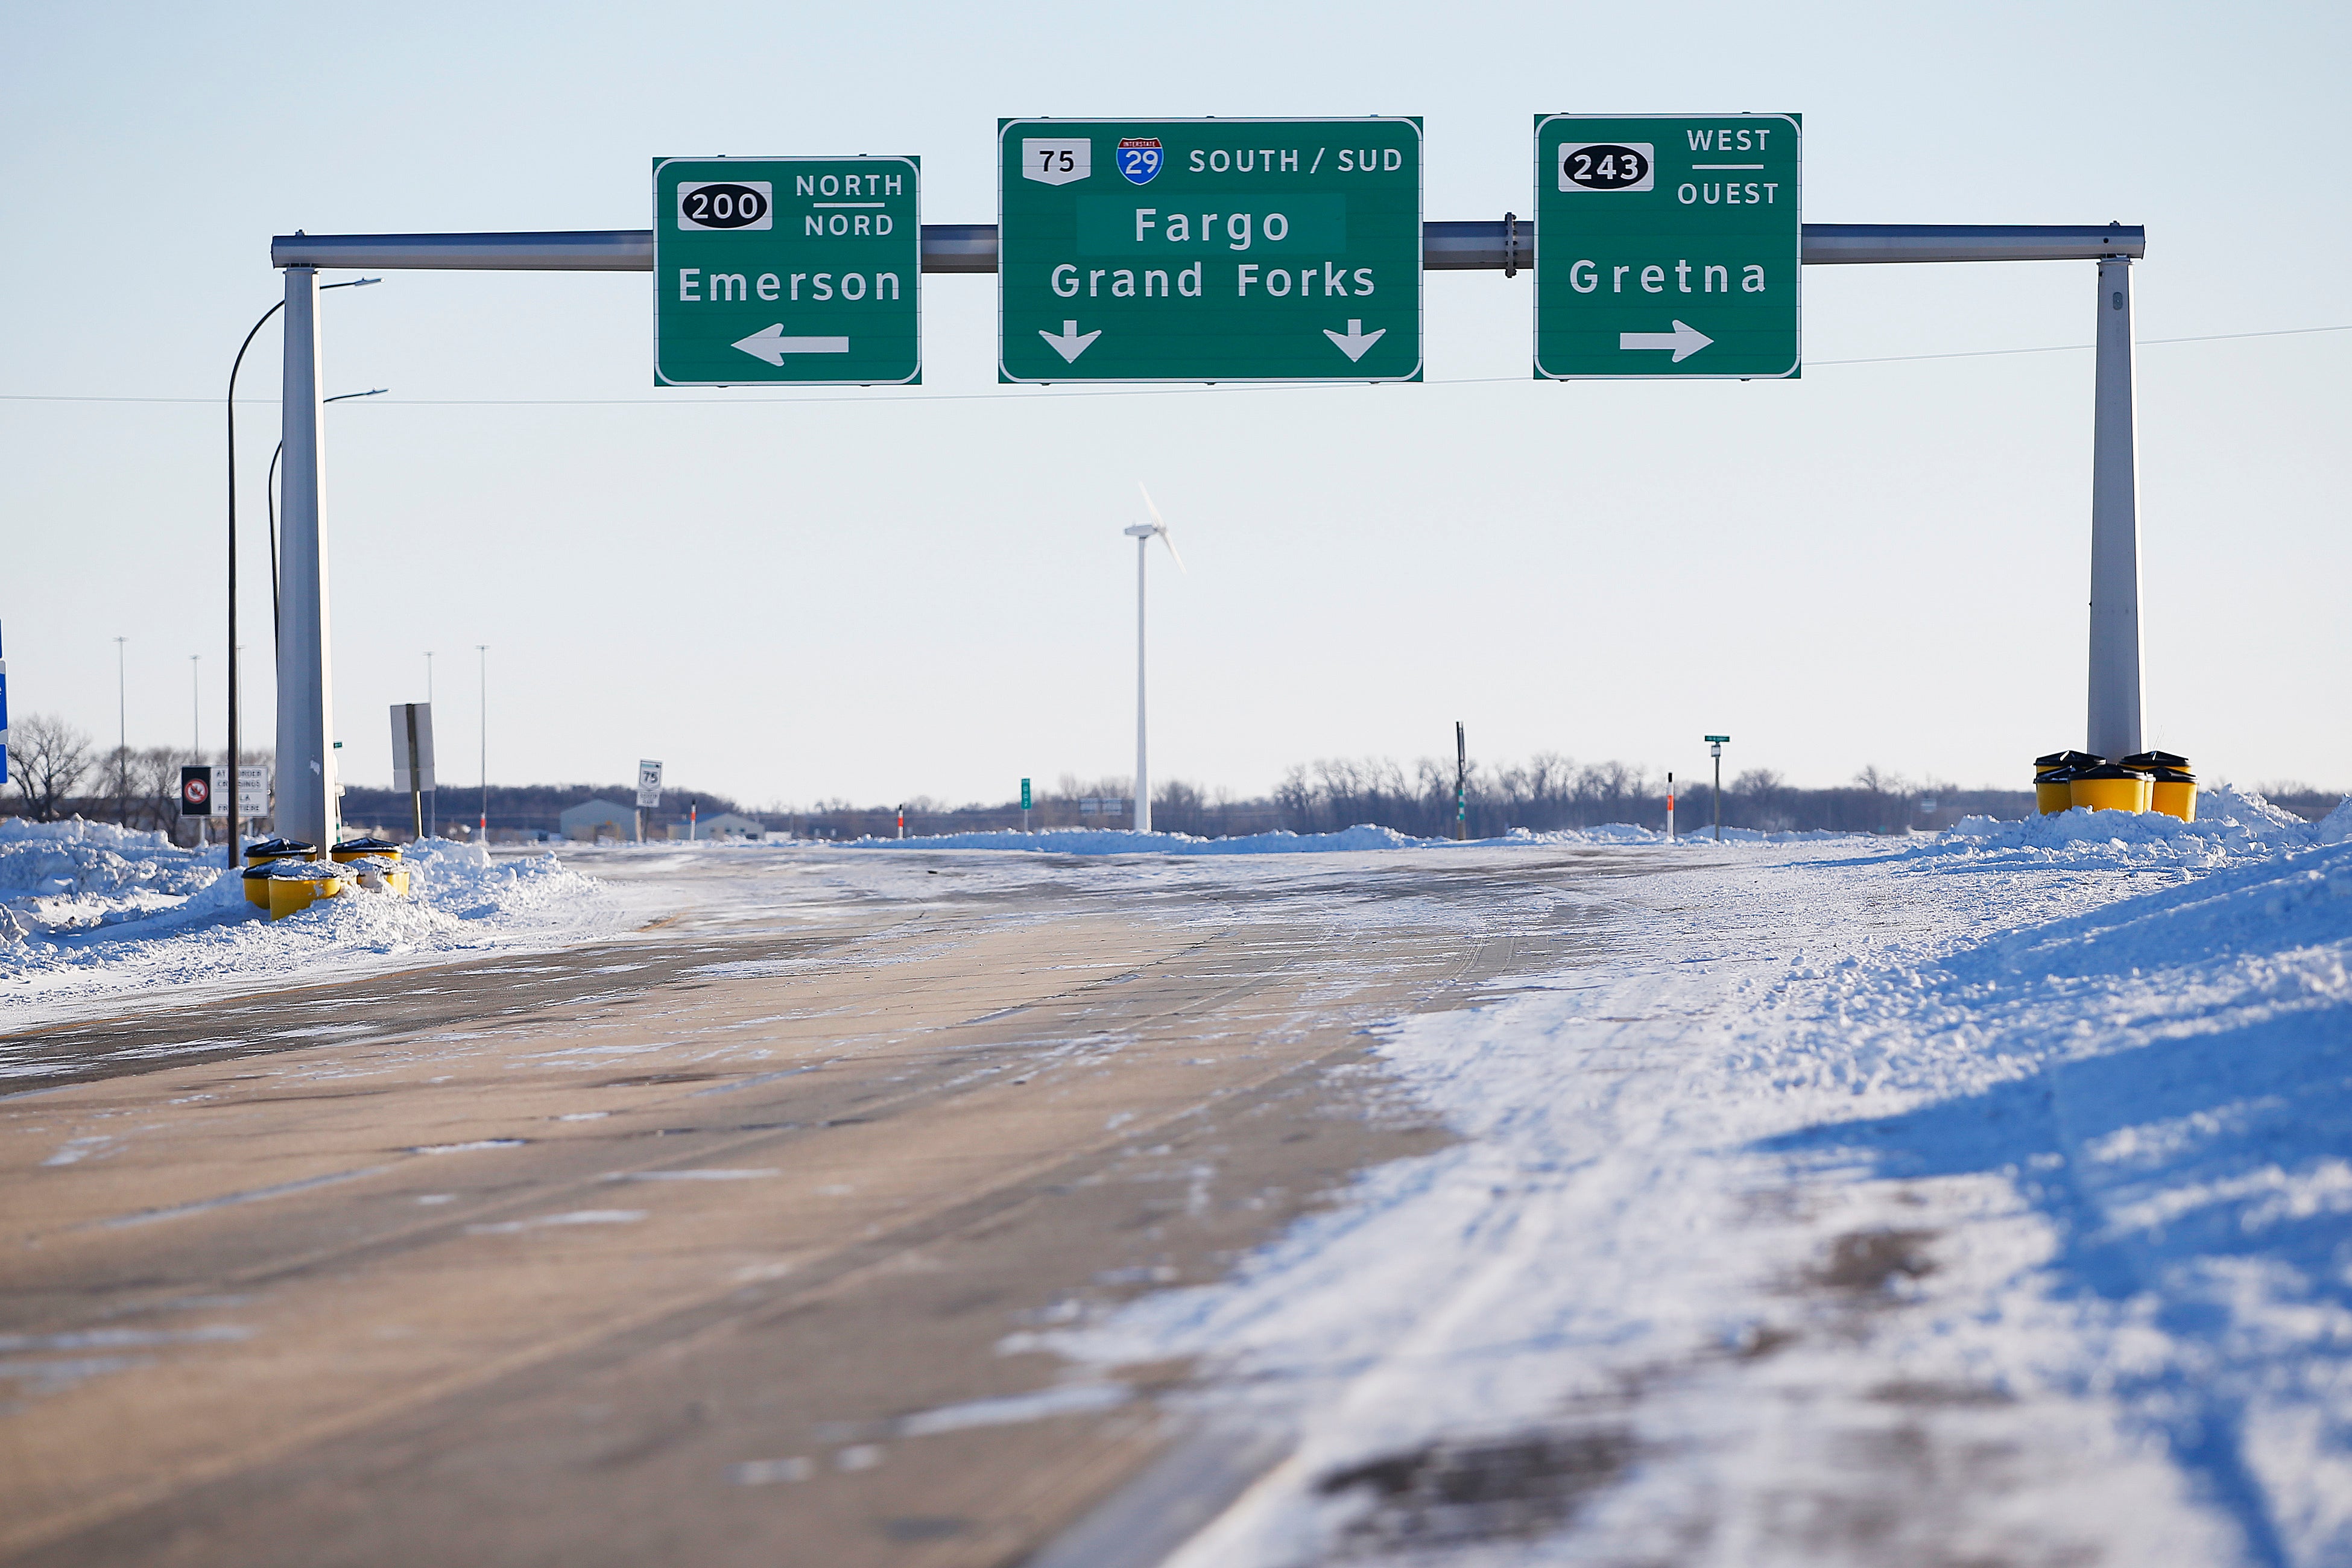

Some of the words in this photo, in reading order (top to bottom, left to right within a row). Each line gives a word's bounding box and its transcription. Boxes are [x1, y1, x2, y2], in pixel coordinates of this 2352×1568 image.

[1687, 129, 1770, 151] WEST
[1039, 150, 1074, 172] 75
[1125, 150, 1159, 174] 29
[1189, 150, 1298, 172] SOUTH
[1310, 147, 1325, 174] /
[1338, 148, 1402, 171] SUD
[1573, 154, 1639, 180] 243
[796, 174, 902, 196] NORTH
[1677, 183, 1778, 204] OUEST
[692, 193, 758, 219] 200
[806, 214, 893, 236] NORD
[1136, 208, 1289, 250] Fargo
[679, 268, 899, 301] Emerson
[1051, 261, 1201, 297] Grand
[1238, 261, 1375, 297] Forks
[1570, 259, 1766, 293] Gretna
[643, 771, 658, 783] 75
